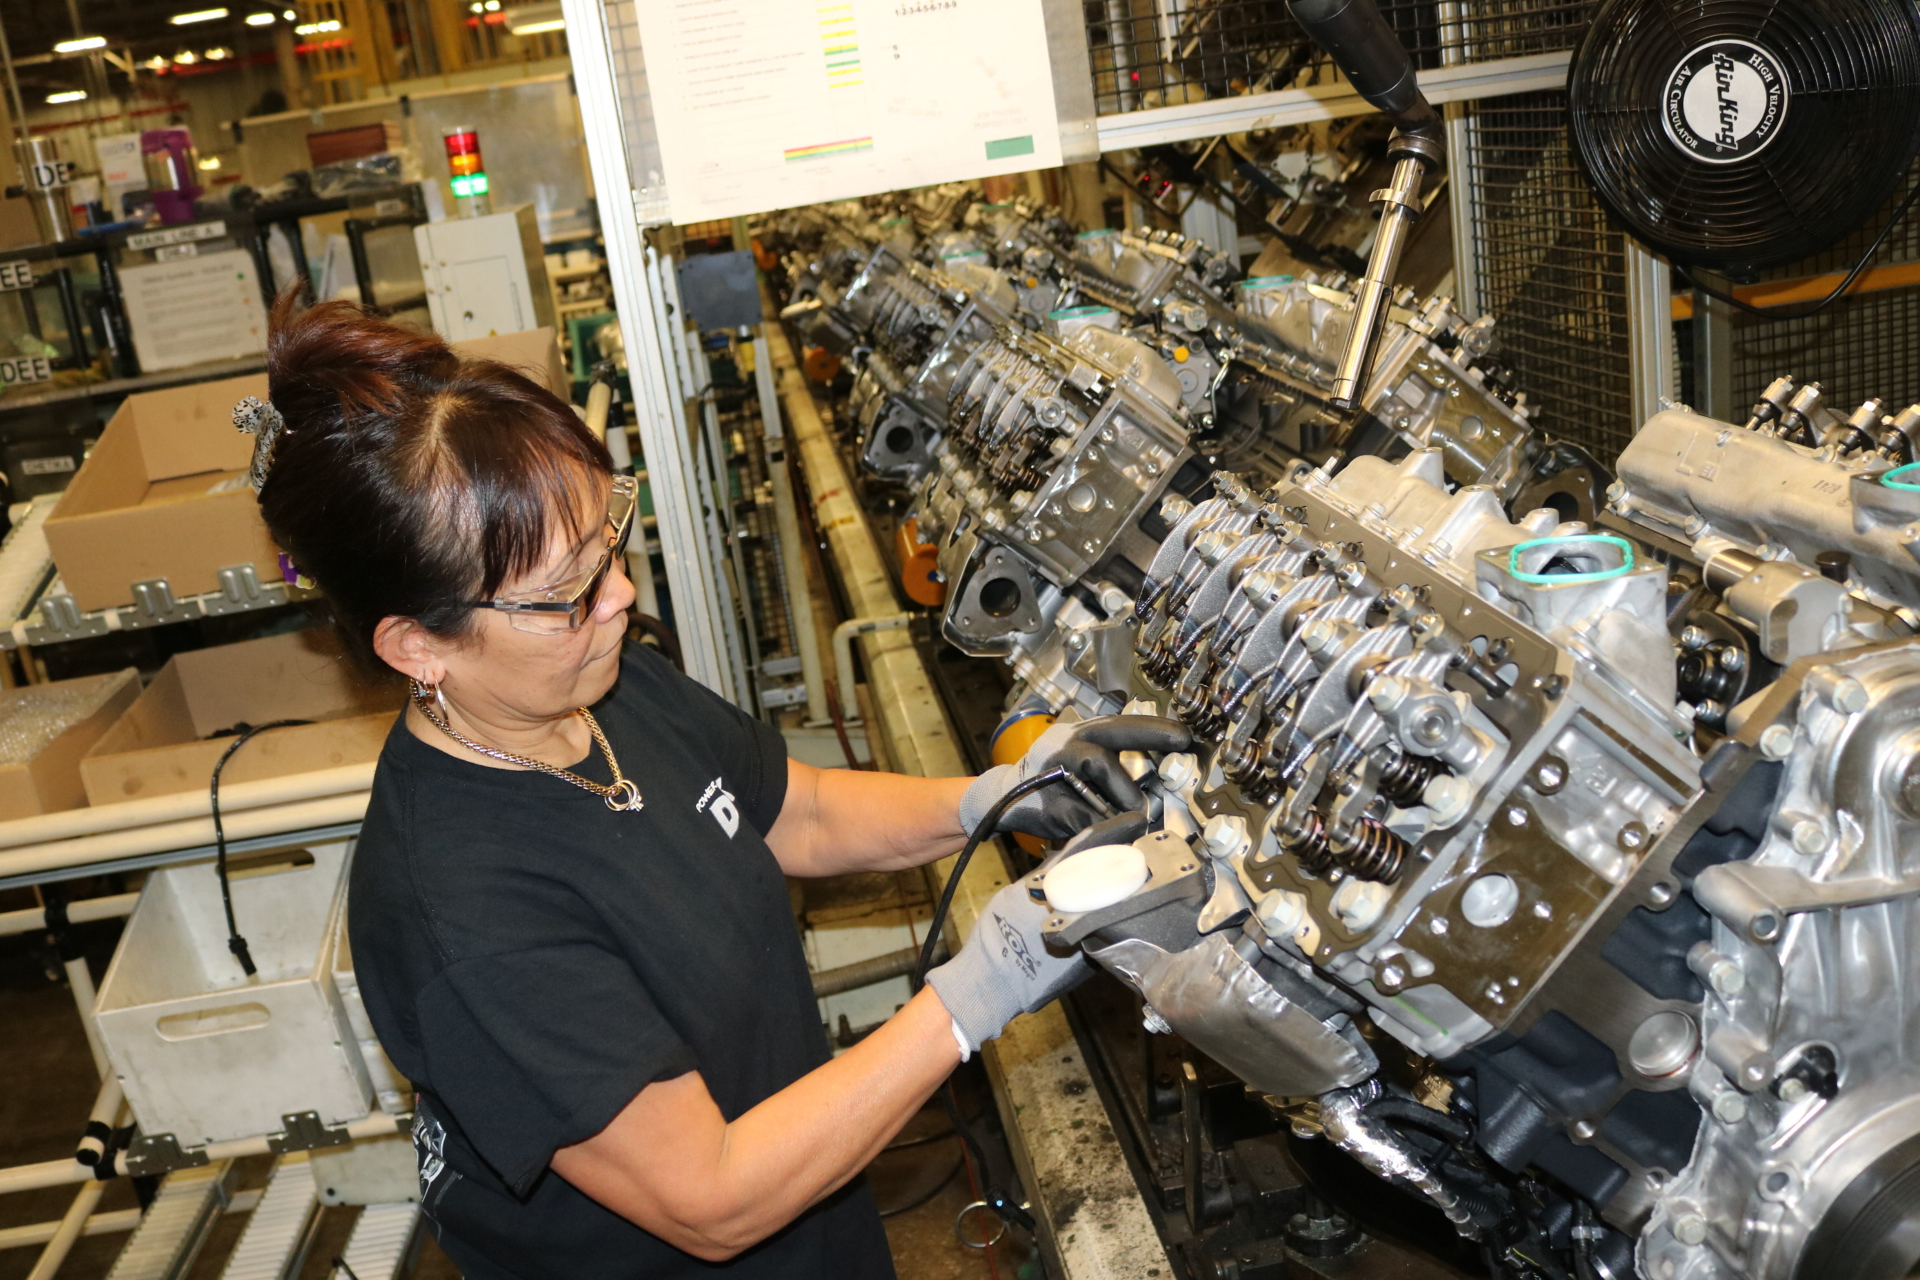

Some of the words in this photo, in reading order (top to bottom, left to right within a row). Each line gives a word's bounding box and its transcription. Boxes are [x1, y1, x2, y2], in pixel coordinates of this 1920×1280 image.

[1674, 65, 1692, 87] AIR
[1712, 52, 1735, 93] Air
[1747, 53, 1774, 83] HIGH
[1670, 89, 1699, 149] CIRCULATOR
[1714, 94, 1738, 150] King
[1756, 84, 1781, 138] VELOCITY
[1, 359, 48, 382] DEE
[695, 781, 718, 813] POWER
